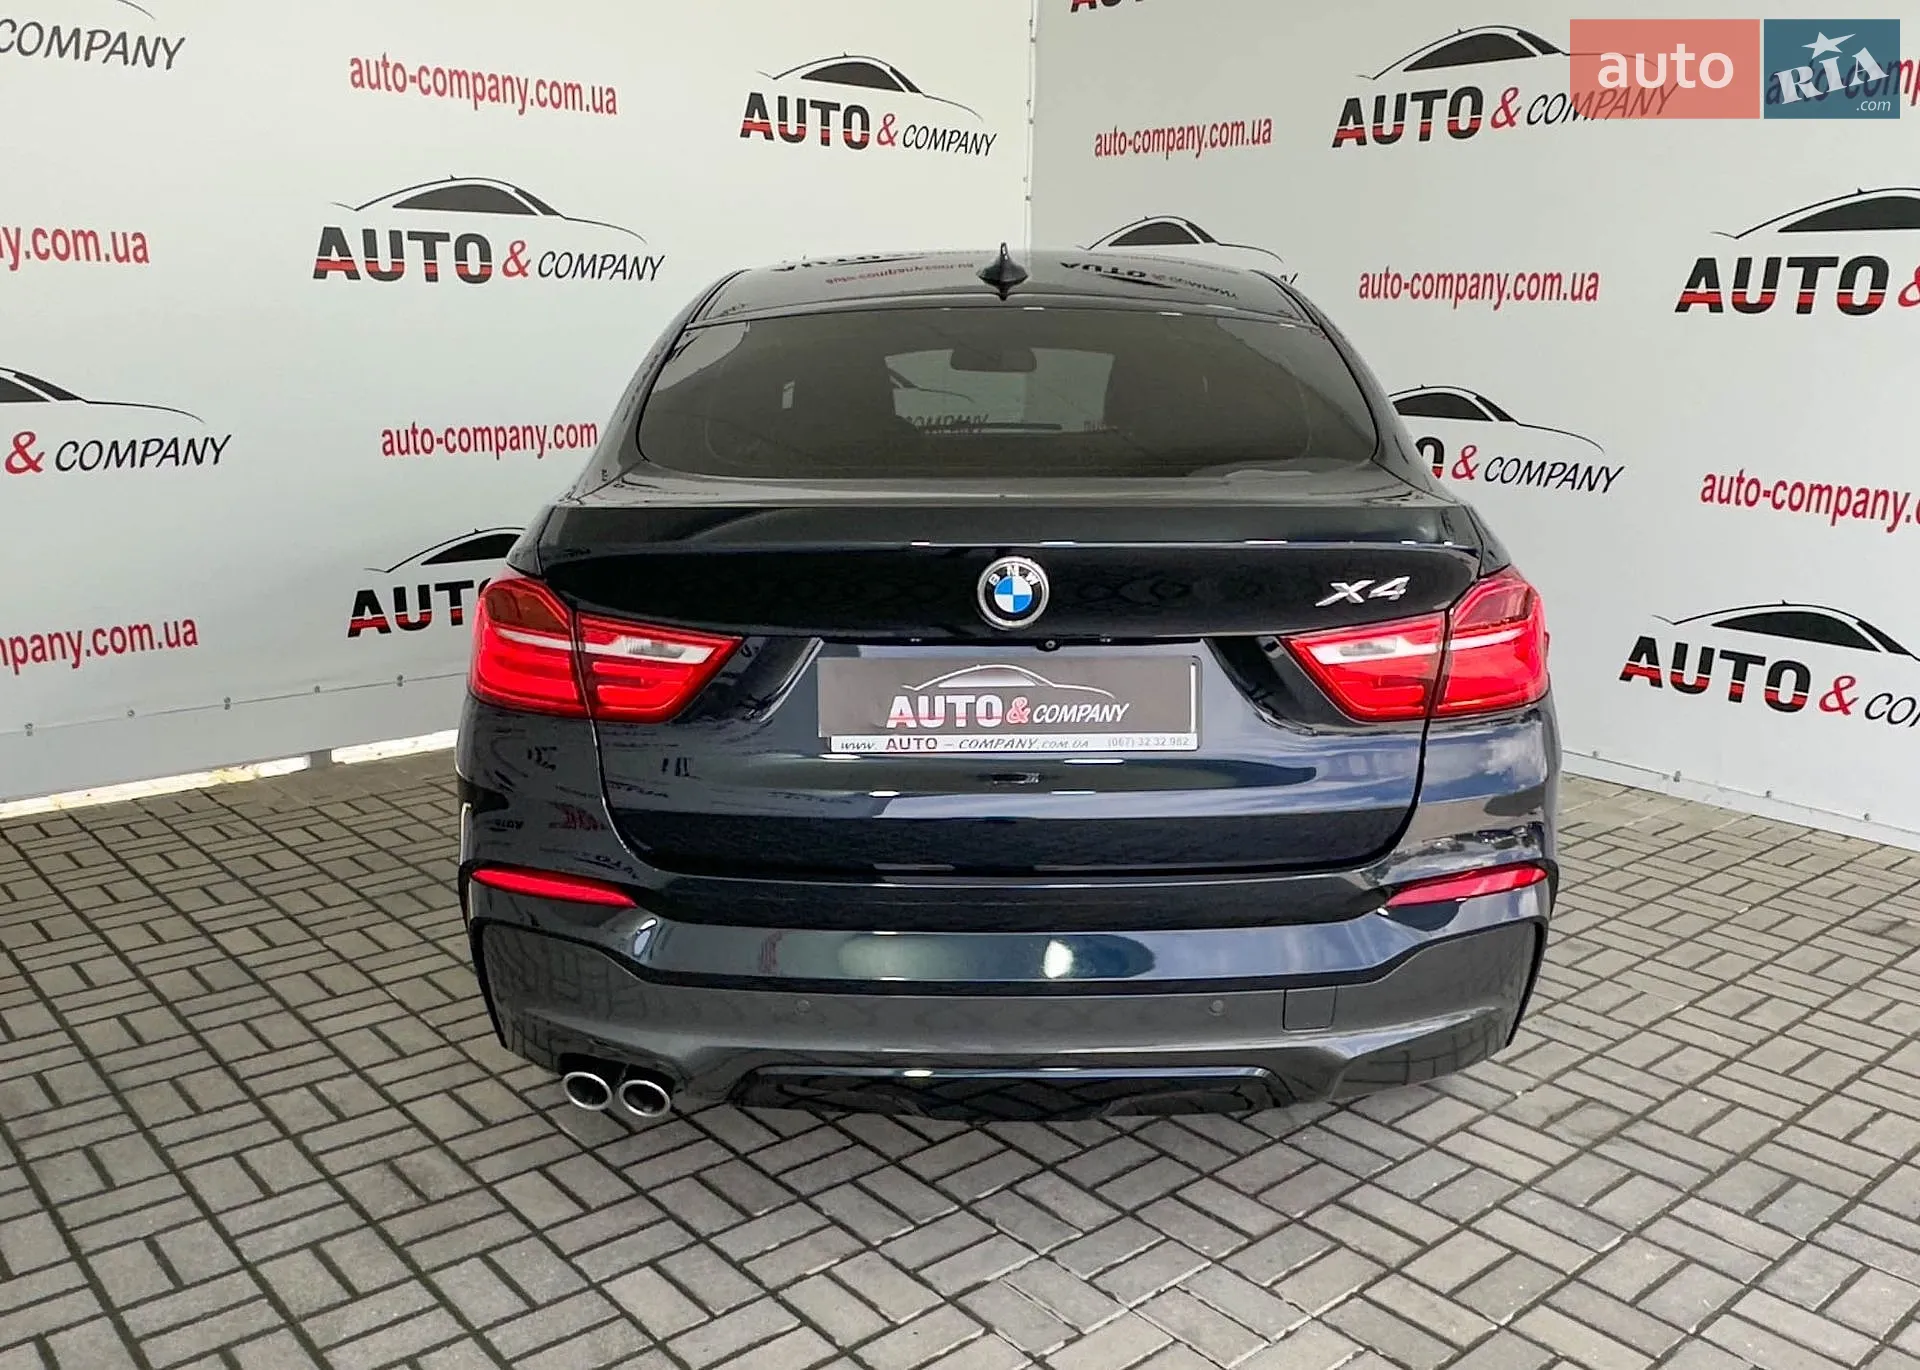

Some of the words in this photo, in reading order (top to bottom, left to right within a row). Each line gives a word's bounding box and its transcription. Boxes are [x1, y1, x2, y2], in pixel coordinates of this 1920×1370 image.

[0, 19, 185, 70] COMPANY
[350, 52, 617, 115] auto-company.com.ua
[740, 92, 870, 150] AUTO
[877, 113, 898, 146] &
[903, 124, 997, 156] COMPANY
[1095, 118, 1272, 160] auto-company.com.ua
[1332, 86, 1483, 148] AUTO
[1491, 87, 1521, 129] &
[1527, 83, 1678, 125] COMPANY
[313, 226, 492, 284] AUTO
[502, 240, 531, 277] &
[538, 251, 665, 281] COMPANY
[1359, 266, 1599, 311] auto-company.com.ua
[1675, 256, 1889, 316] AUTO
[5, 431, 45, 474] &
[55, 434, 232, 471] COMPANY
[382, 422, 598, 460] auto-company.com
[1452, 445, 1480, 480] &
[1484, 456, 1624, 493] COMPANY
[1701, 469, 1920, 533] auto-company.
[988, 564, 1041, 586] BMW
[1315, 575, 1410, 607] X4
[348, 578, 491, 638] AUT
[1619, 636, 1811, 713] AUTO
[1819, 675, 1859, 716] &
[1865, 693, 1920, 727] CO
[887, 695, 1002, 727] AUTO
[1006, 697, 1031, 723] &
[1033, 703, 1130, 723] COMPANY
[886, 737, 938, 750] AUTO
